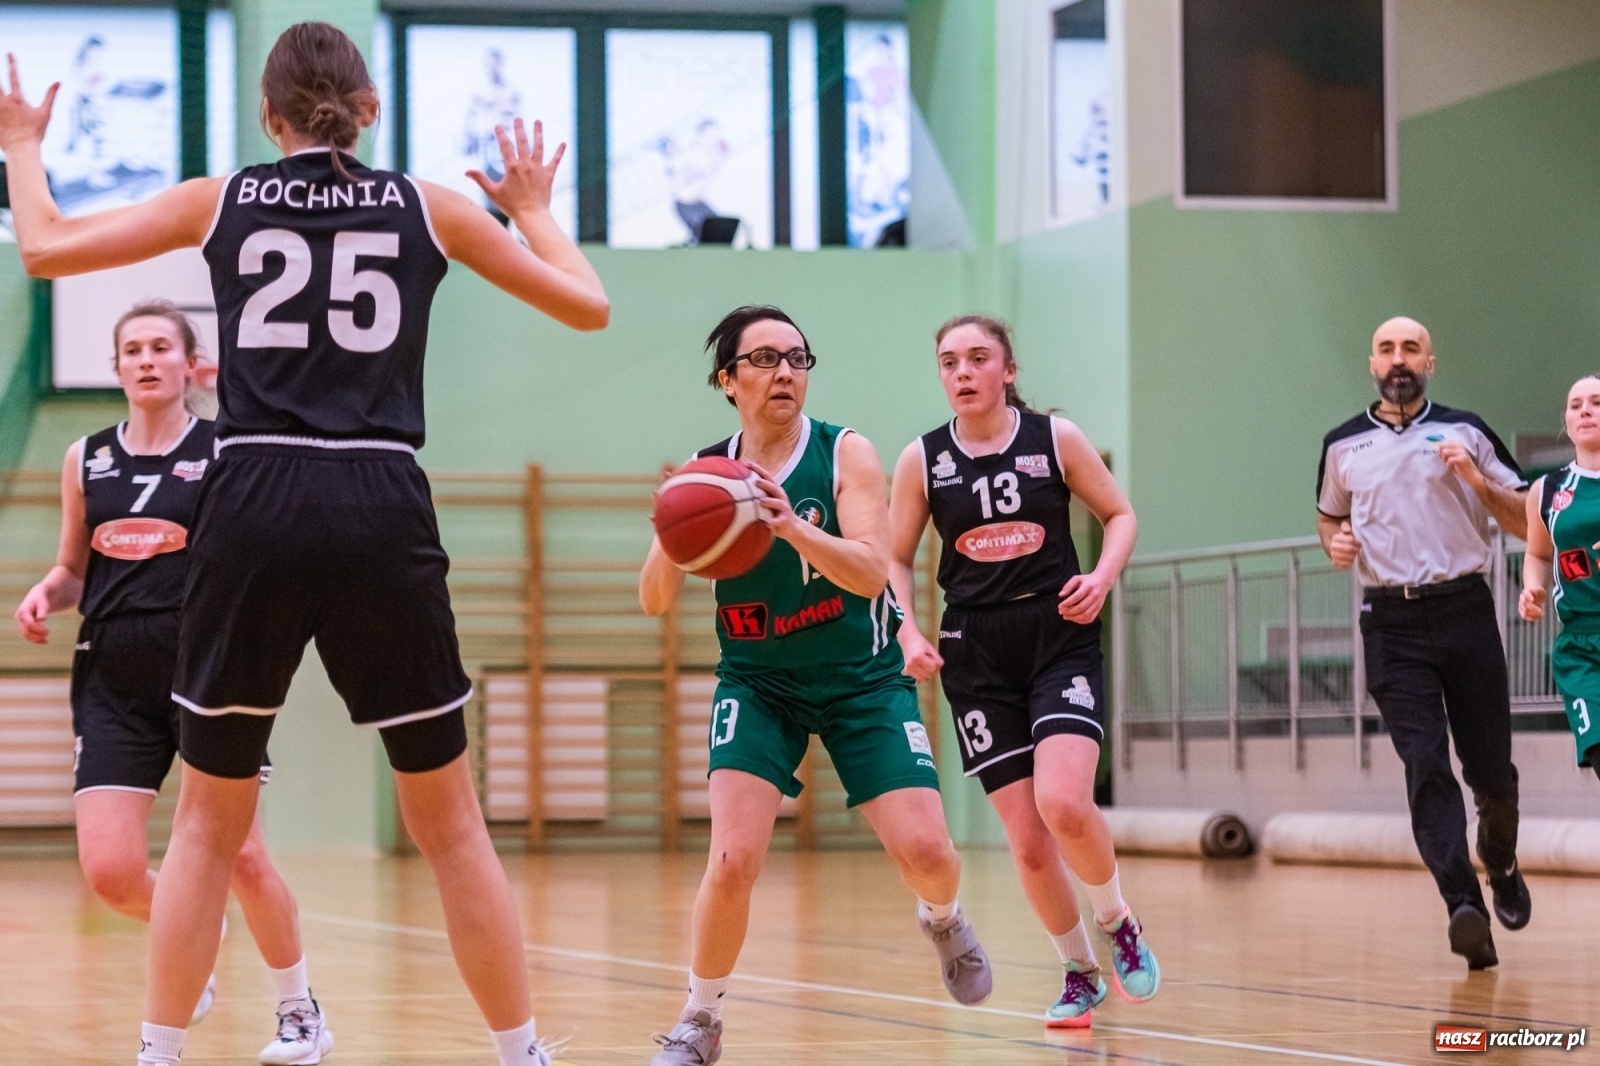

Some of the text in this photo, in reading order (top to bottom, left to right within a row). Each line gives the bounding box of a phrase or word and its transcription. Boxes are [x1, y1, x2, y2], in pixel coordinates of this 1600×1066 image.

[237, 177, 405, 209] BOCHNIA
[237, 228, 401, 353] 25
[130, 474, 162, 513] 7
[932, 476, 963, 488] SPALDING
[972, 471, 1021, 519] 13
[965, 532, 1037, 552] CONTIMAX
[721, 595, 845, 635] K KAMAN
[711, 698, 740, 749] 13
[957, 709, 993, 759] 13
[1573, 697, 1591, 736] 3
